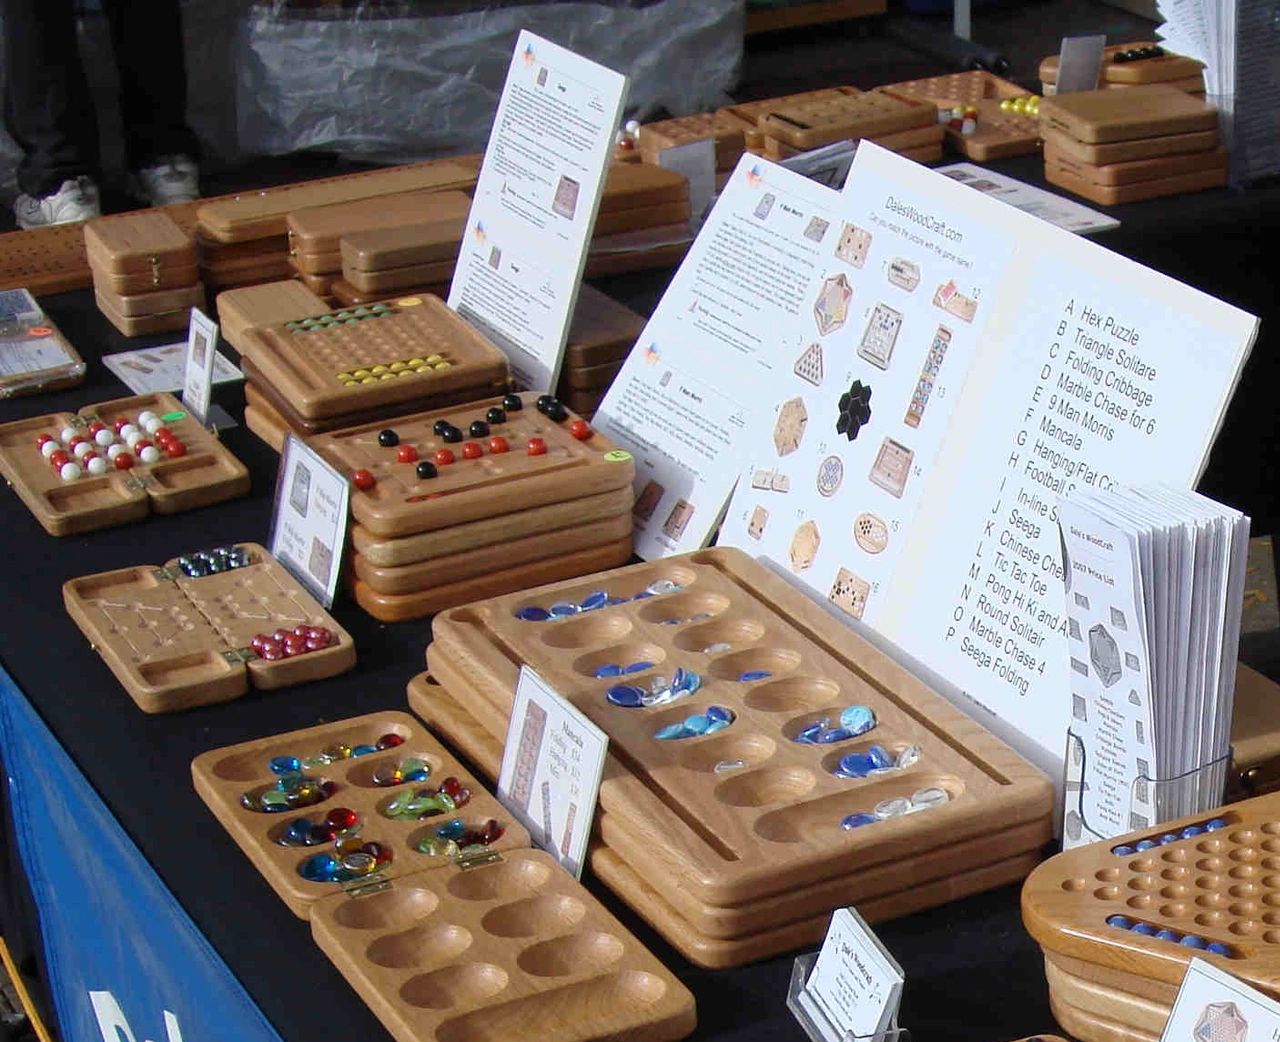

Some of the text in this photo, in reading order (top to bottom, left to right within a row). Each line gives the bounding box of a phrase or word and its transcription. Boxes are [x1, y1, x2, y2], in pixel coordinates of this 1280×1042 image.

[885, 196, 964, 244] DalesWoodCraft.com
[1065, 299, 1140, 346] A Hex Puzzle
[1050, 343, 1153, 407] C Folding Cribbage
[1057, 320, 1156, 381] B Triangle Solitare
[1033, 386, 1115, 441] E 9 Man Morris
[1041, 364, 1155, 434] D Marble Chase for 6
[1024, 408, 1083, 450] F Mancala
[1008, 451, 1019, 468] H
[1024, 460, 1066, 495] Football
[1017, 430, 1028, 446] G
[1033, 439, 1098, 486] Hanging/Flat
[992, 499, 1001, 514] J
[1009, 508, 1041, 539] Seega
[1000, 476, 1006, 492] I
[1017, 487, 1048, 516] In-line
[976, 541, 1047, 596] L Tic Tac Toe
[984, 520, 995, 536] K
[1000, 530, 1040, 565] Chinese
[961, 583, 1046, 648] N Round Solitair
[968, 562, 981, 581] M
[985, 573, 1012, 604] Pong
[1012, 590, 1027, 610] Hi
[1024, 598, 1037, 617] Ki
[1038, 609, 1060, 630] and
[945, 626, 1030, 697] P Seega Folding
[953, 605, 1047, 676] O Marble Chase 4
